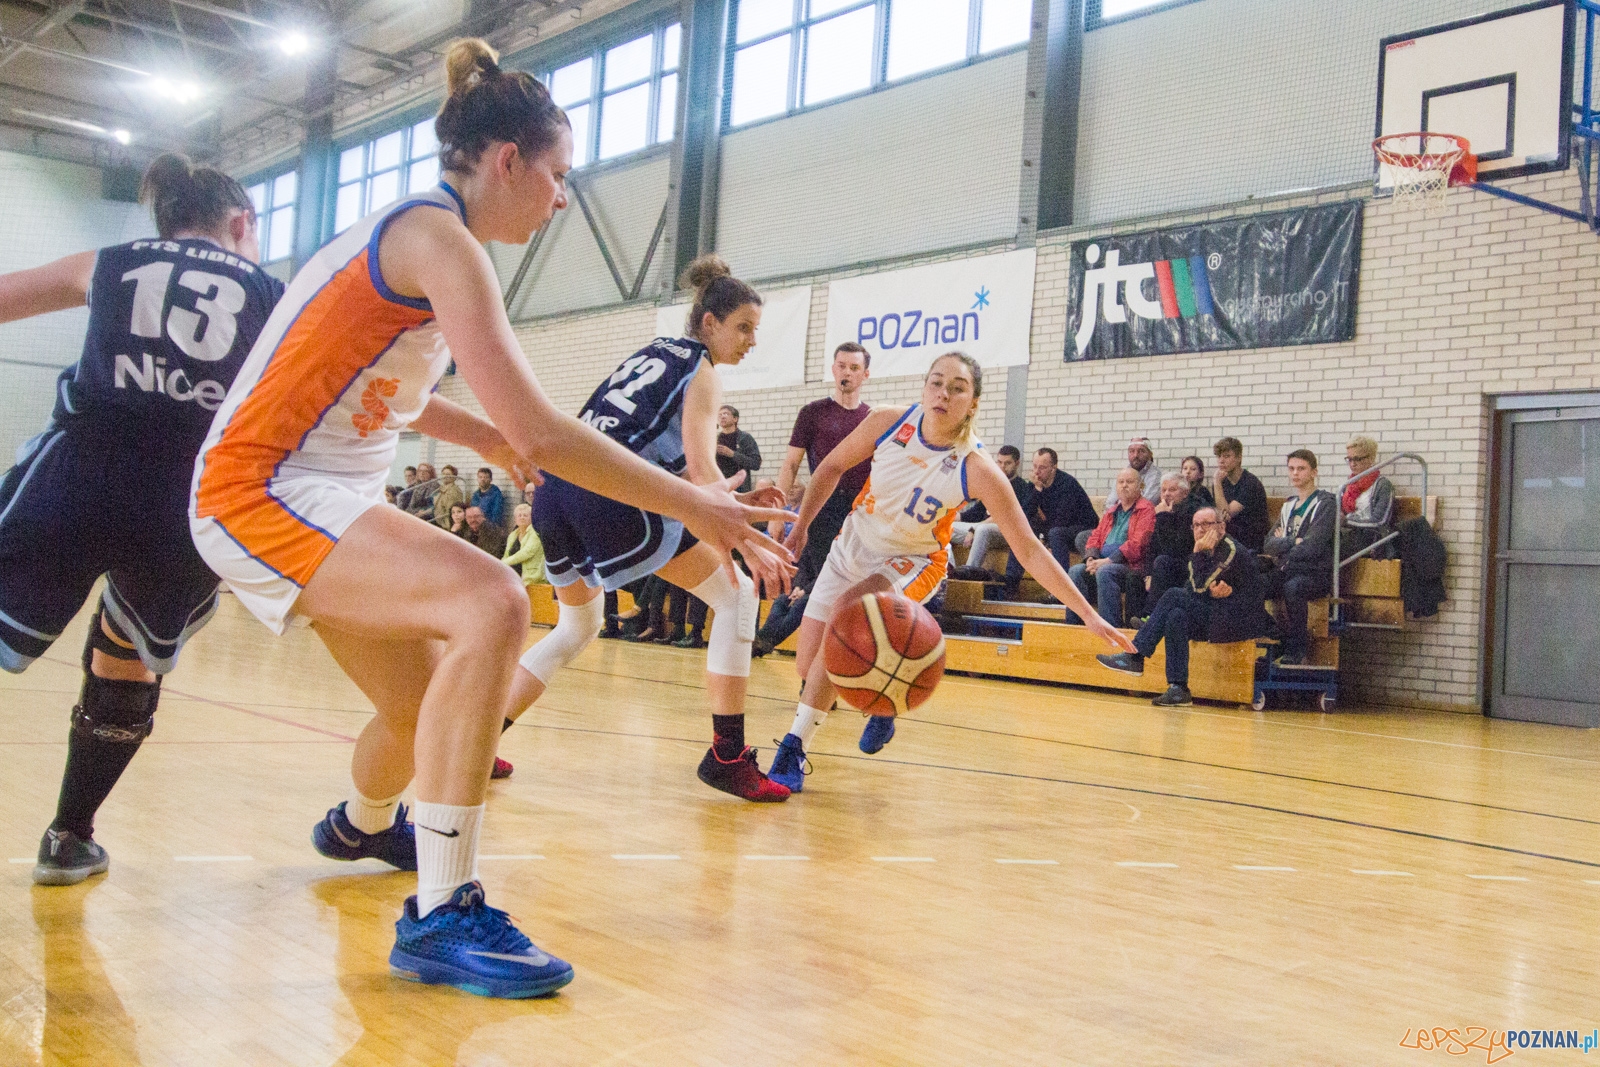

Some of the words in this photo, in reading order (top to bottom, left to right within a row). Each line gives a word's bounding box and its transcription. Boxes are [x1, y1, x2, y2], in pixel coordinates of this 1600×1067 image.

[131, 240, 180, 253] PTS
[185, 246, 254, 273] LIDER
[121, 261, 247, 362] 13
[114, 352, 227, 411] Nice
[604, 354, 667, 416] 12
[903, 486, 944, 525] 13
